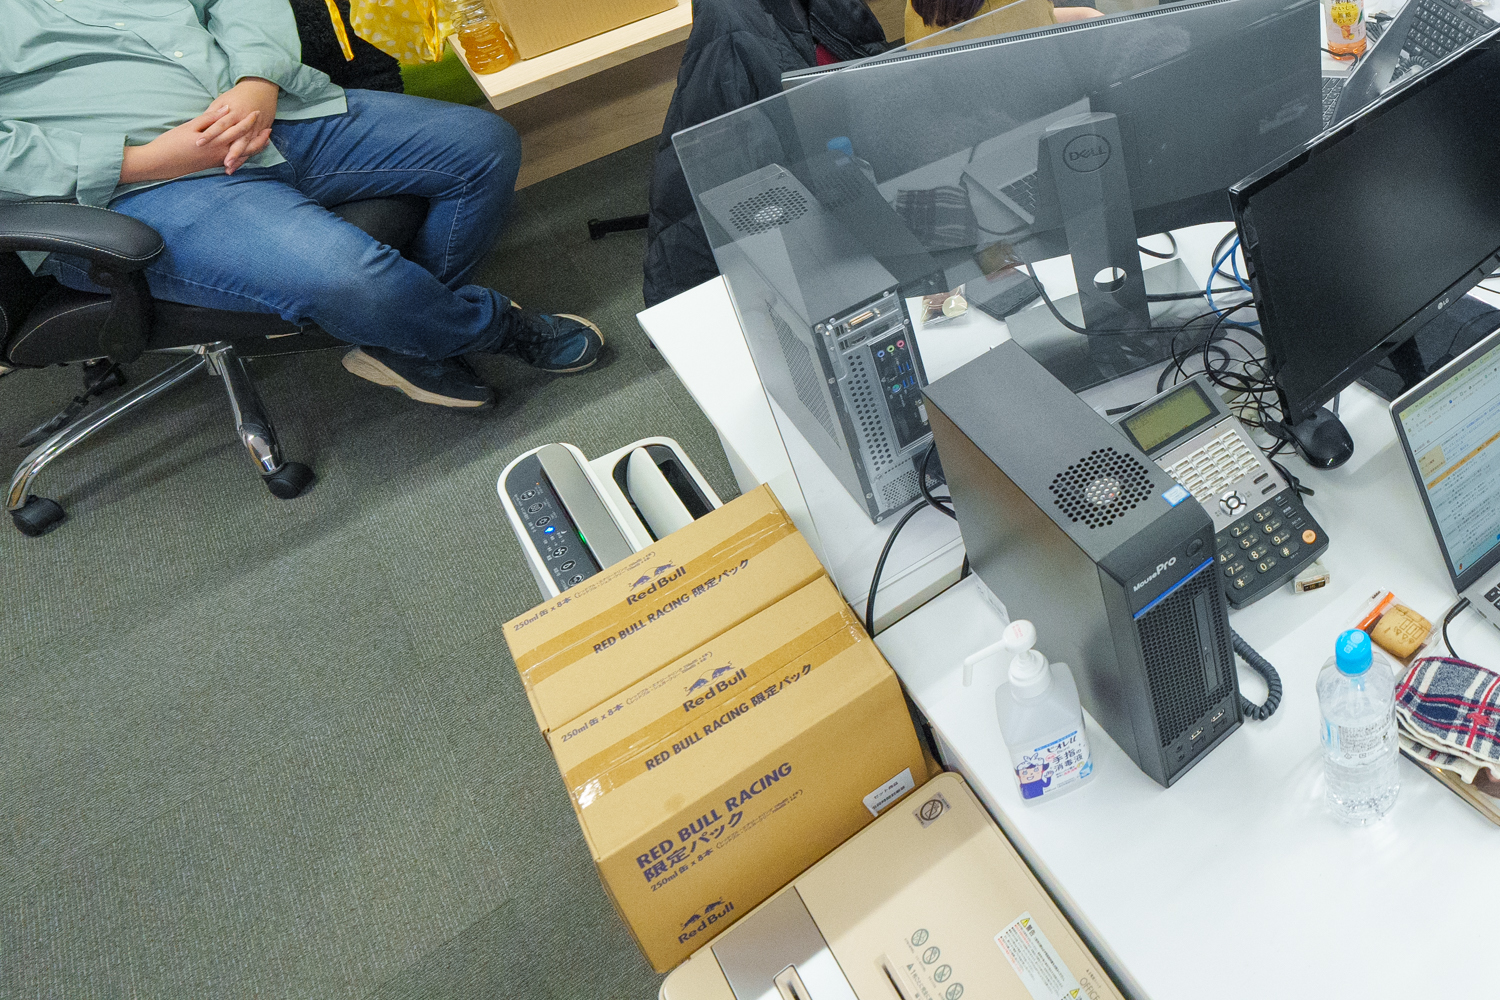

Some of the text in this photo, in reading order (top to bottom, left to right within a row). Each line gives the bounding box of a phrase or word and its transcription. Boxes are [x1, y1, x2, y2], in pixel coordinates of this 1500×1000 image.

[1068, 145, 1107, 161] DELL
[1255, 512, 1264, 522] 3
[1234, 526, 1242, 536] 2
[1264, 524, 1273, 533] 6
[1241, 538, 1250, 548] 5
[1273, 535, 1282, 544] 9
[1220, 553, 1227, 563] 4
[1250, 550, 1259, 560] 8
[1282, 546, 1290, 556] #
[1132, 556, 1177, 592] MousePro
[1227, 566, 1235, 576] 7
[1259, 562, 1268, 572] 0
[625, 585, 657, 606] Red
[658, 566, 688, 589] Bull
[513, 613, 539, 632] 250ml
[556, 596, 573, 608] 8本
[592, 556, 751, 655] RED BULL RACING 限定パック
[681, 686, 717, 714] Red
[715, 667, 748, 695] Bull
[560, 723, 589, 744] 250ml
[588, 716, 600, 728] 缶
[606, 703, 624, 718] 8本
[644, 662, 813, 772] RED BULL RACING 限定パック
[1052, 748, 1082, 765] 手指の
[1053, 754, 1084, 773] 消毒液
[635, 838, 676, 870] RED
[677, 807, 723, 843] BULL
[724, 760, 793, 813] RACING
[642, 809, 746, 884] 限定パック
[649, 870, 679, 893] 250ml
[677, 862, 690, 876] 缶
[696, 848, 714, 863] 8本
[677, 900, 736, 946] Red Bull
